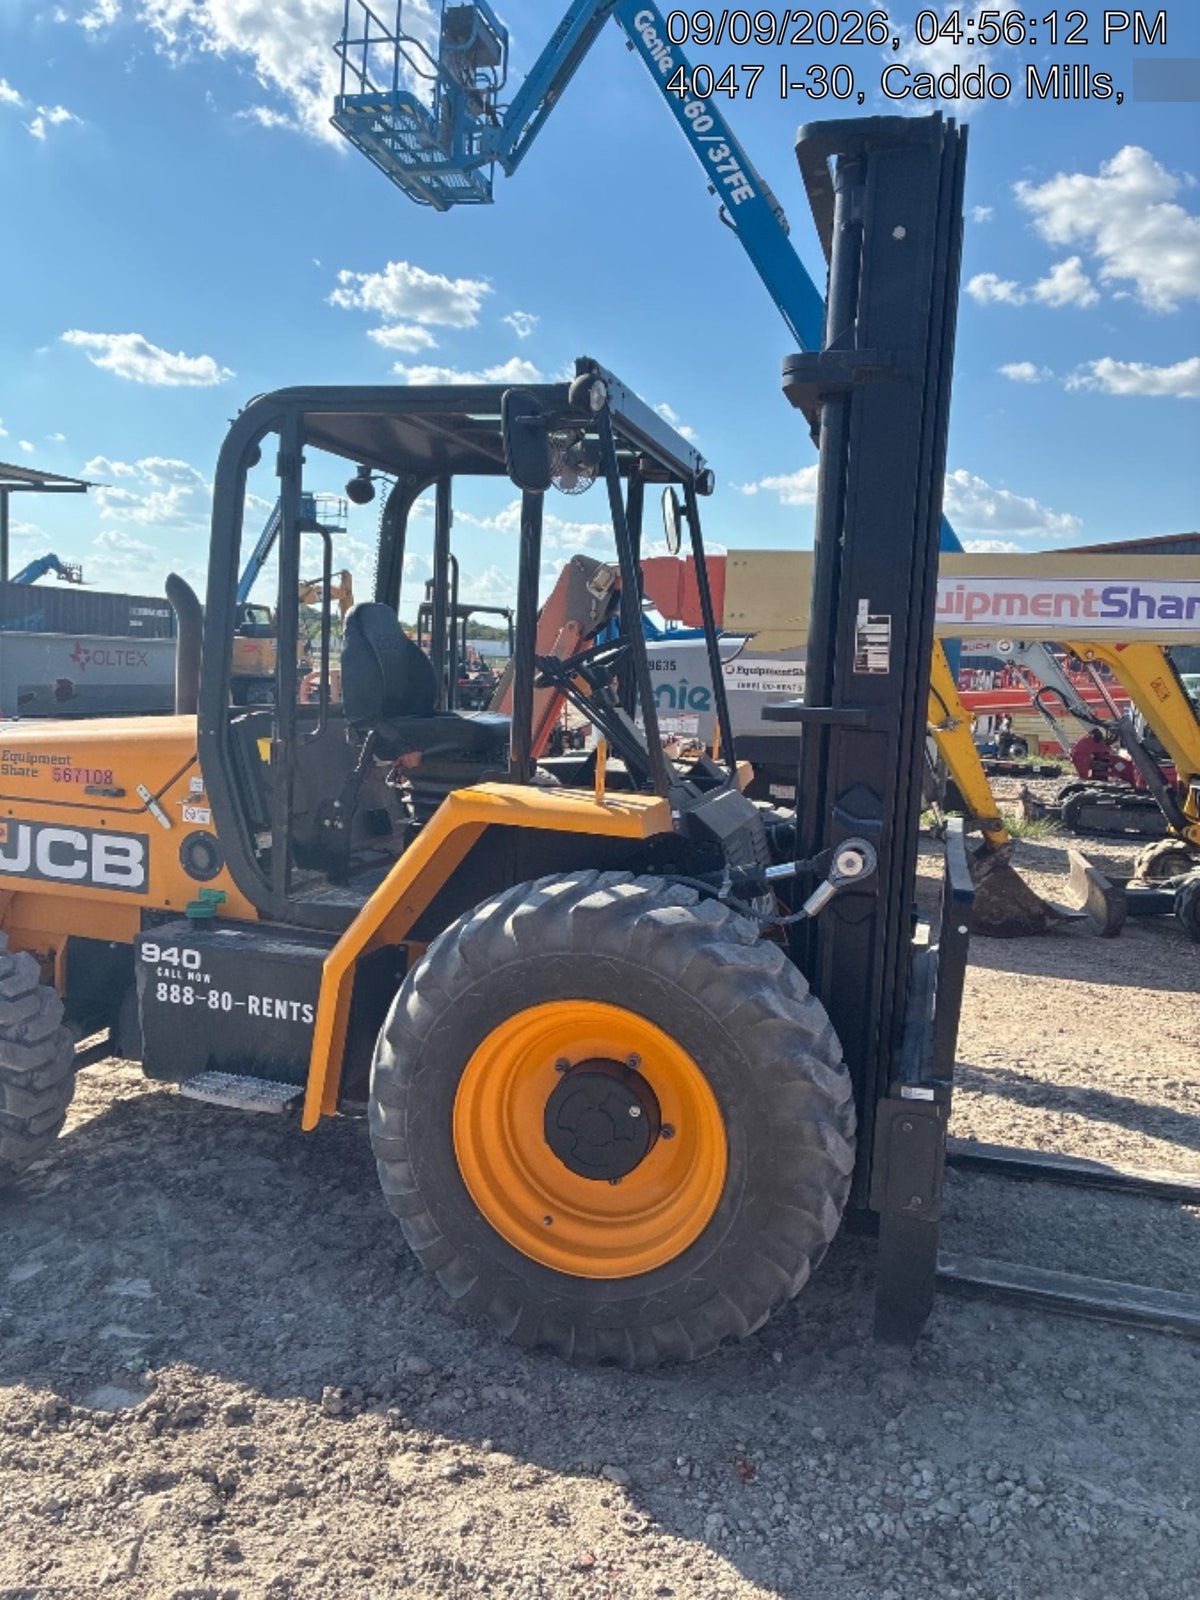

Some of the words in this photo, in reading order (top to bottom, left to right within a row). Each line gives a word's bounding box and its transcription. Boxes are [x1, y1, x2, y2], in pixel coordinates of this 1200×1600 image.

[634, 10, 674, 76] Genie
[1, 749, 72, 766] Equipment
[1, 764, 38, 777] Share
[53, 767, 114, 785] 567108
[0, 824, 145, 887] JCB
[141, 942, 201, 969] 940
[157, 967, 182, 979] CALL
[187, 971, 212, 984] NOW
[156, 982, 314, 1024] 888-80-RENTS
